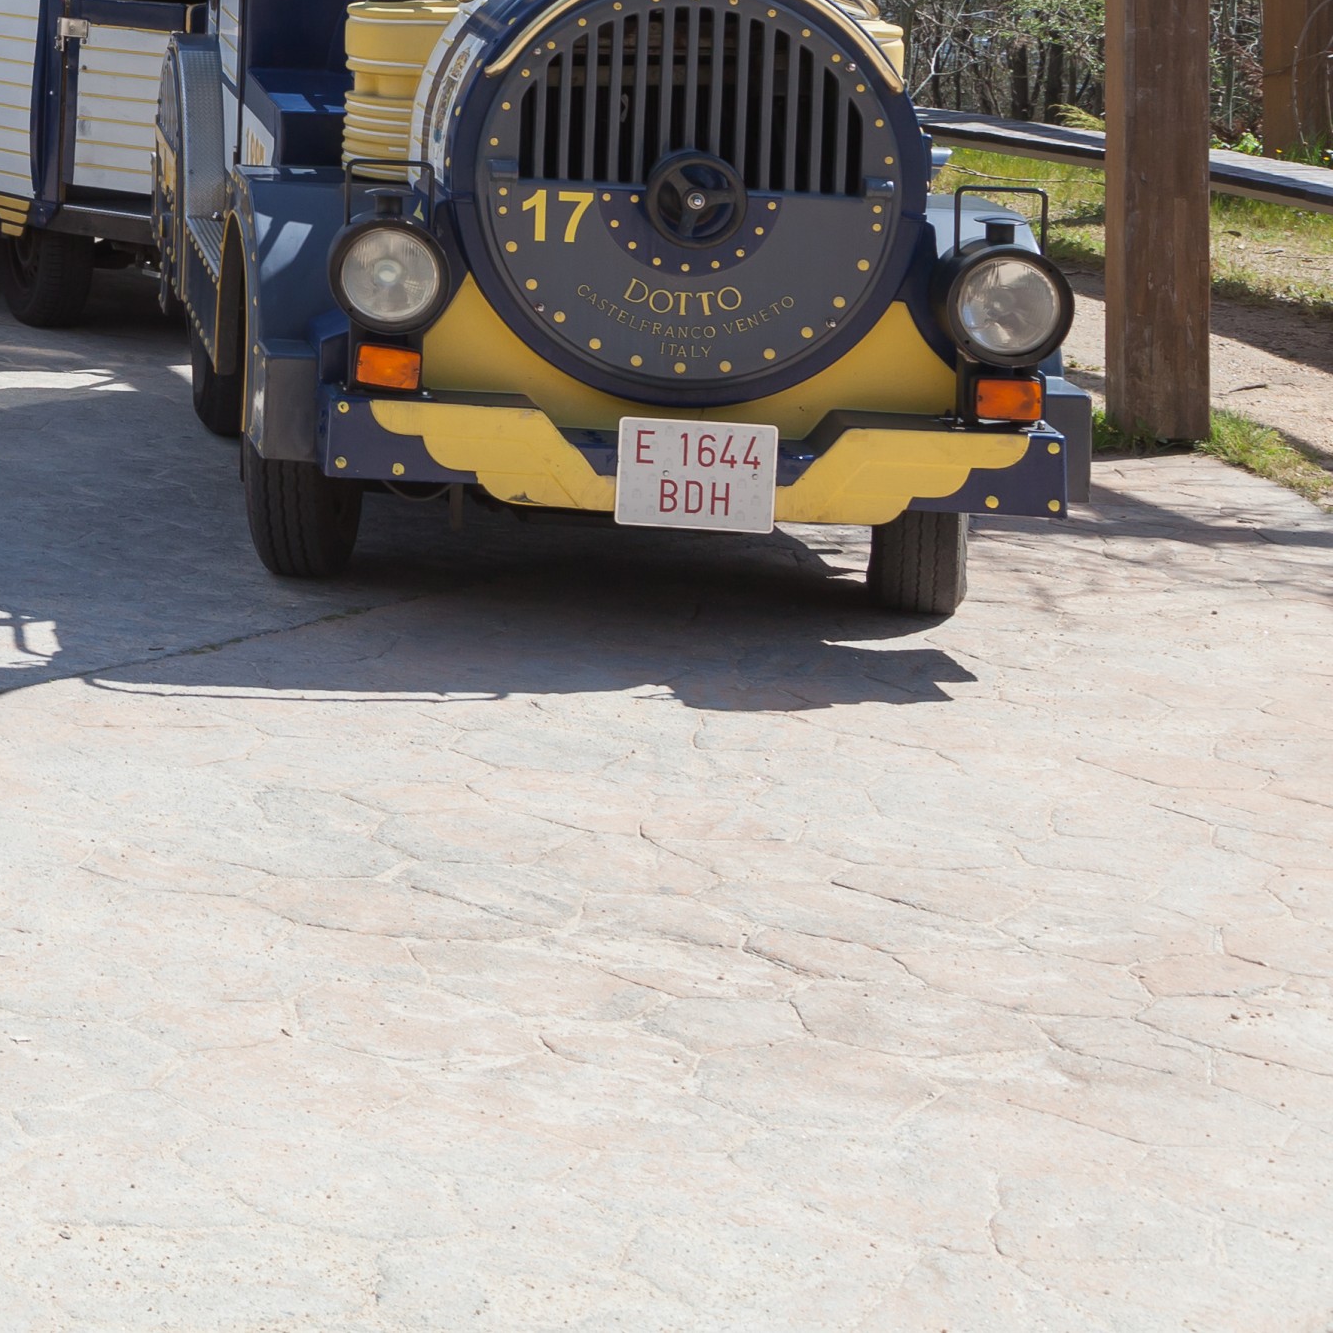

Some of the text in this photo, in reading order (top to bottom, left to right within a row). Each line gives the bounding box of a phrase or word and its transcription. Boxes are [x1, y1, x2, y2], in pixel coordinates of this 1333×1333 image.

[521, 189, 594, 243] 17
[576, 283, 795, 339] CASTELFRANCO VENETO
[623, 277, 743, 316] DOTTO
[660, 341, 712, 358] ITALY
[635, 429, 761, 470] E 1644
[659, 479, 730, 517] BDH
